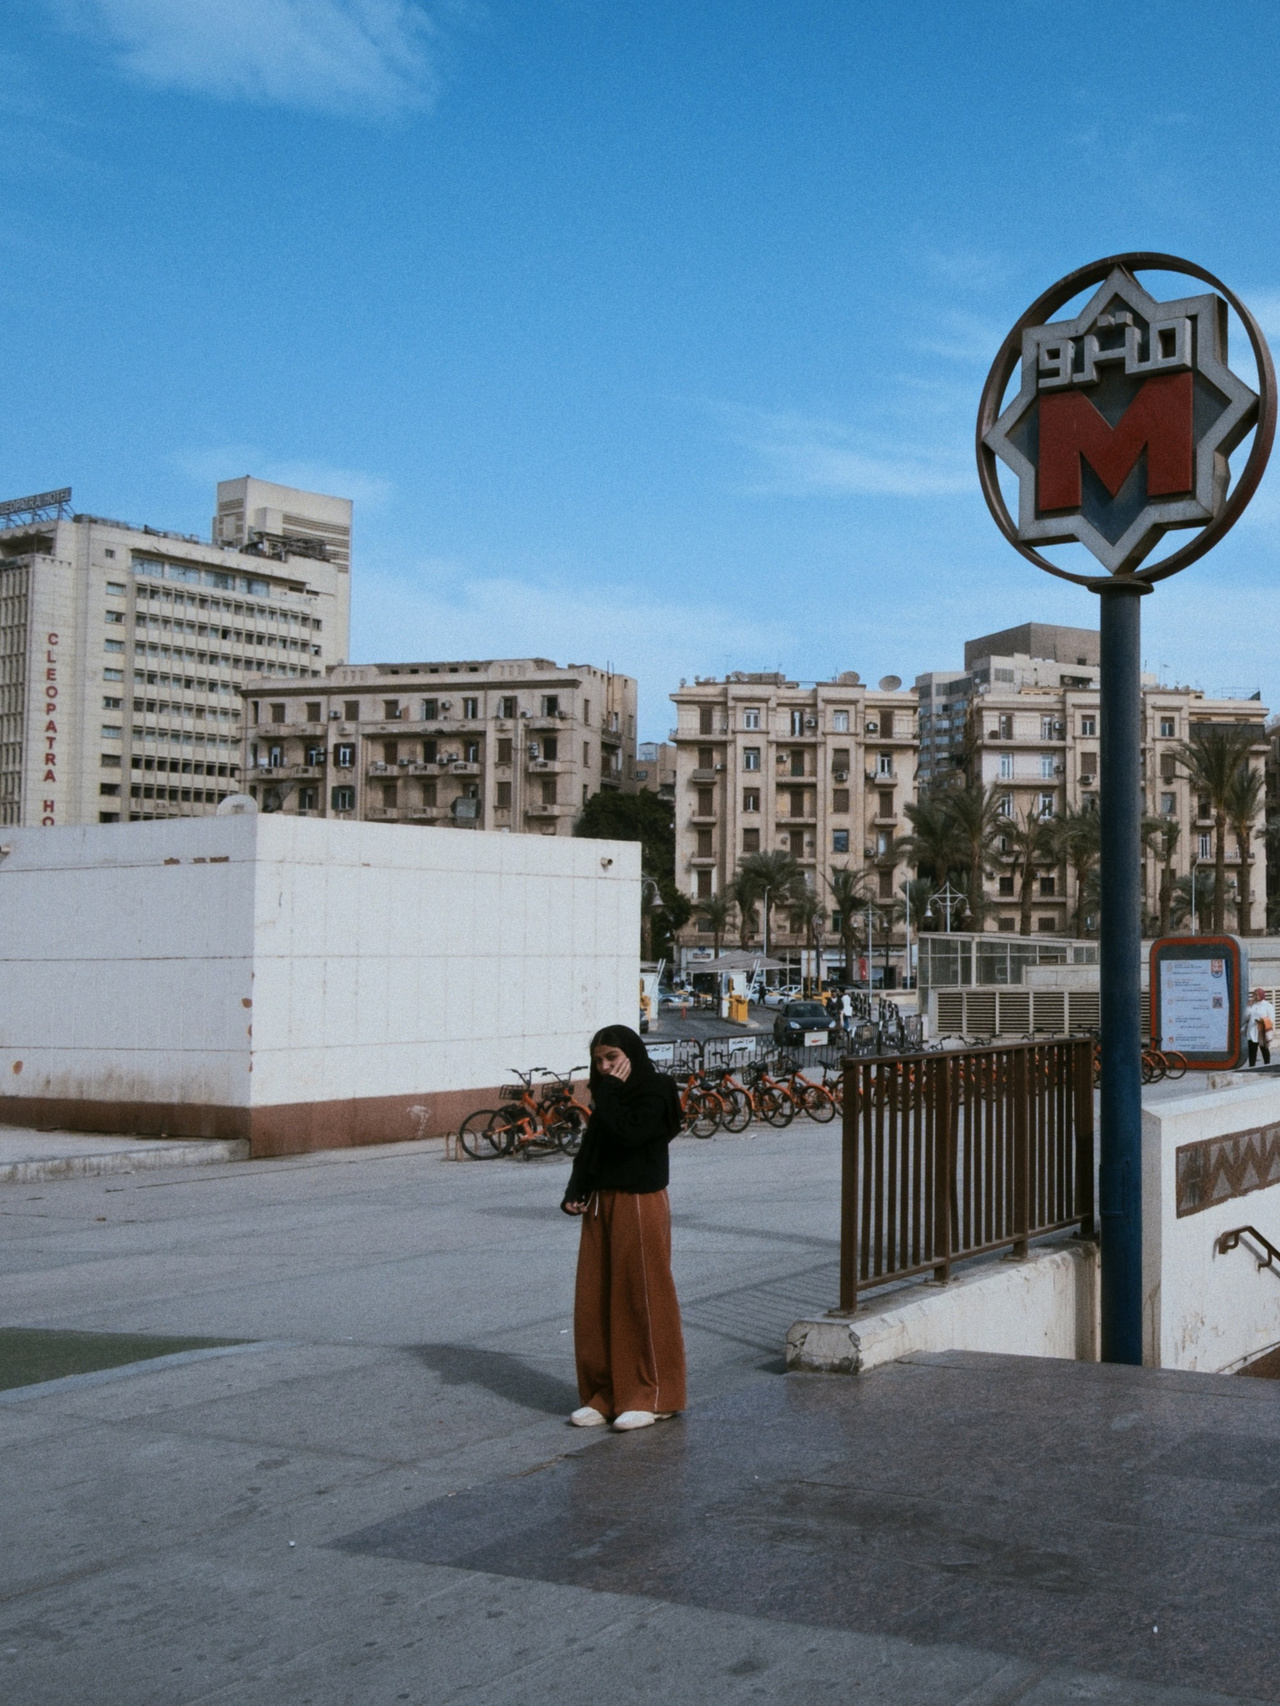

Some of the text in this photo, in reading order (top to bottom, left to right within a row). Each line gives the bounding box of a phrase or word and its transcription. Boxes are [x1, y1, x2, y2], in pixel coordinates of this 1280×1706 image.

[1038, 311, 1193, 389] مترو
[1038, 371, 1194, 512] M
[43, 632, 59, 783] CLEOPATRA
